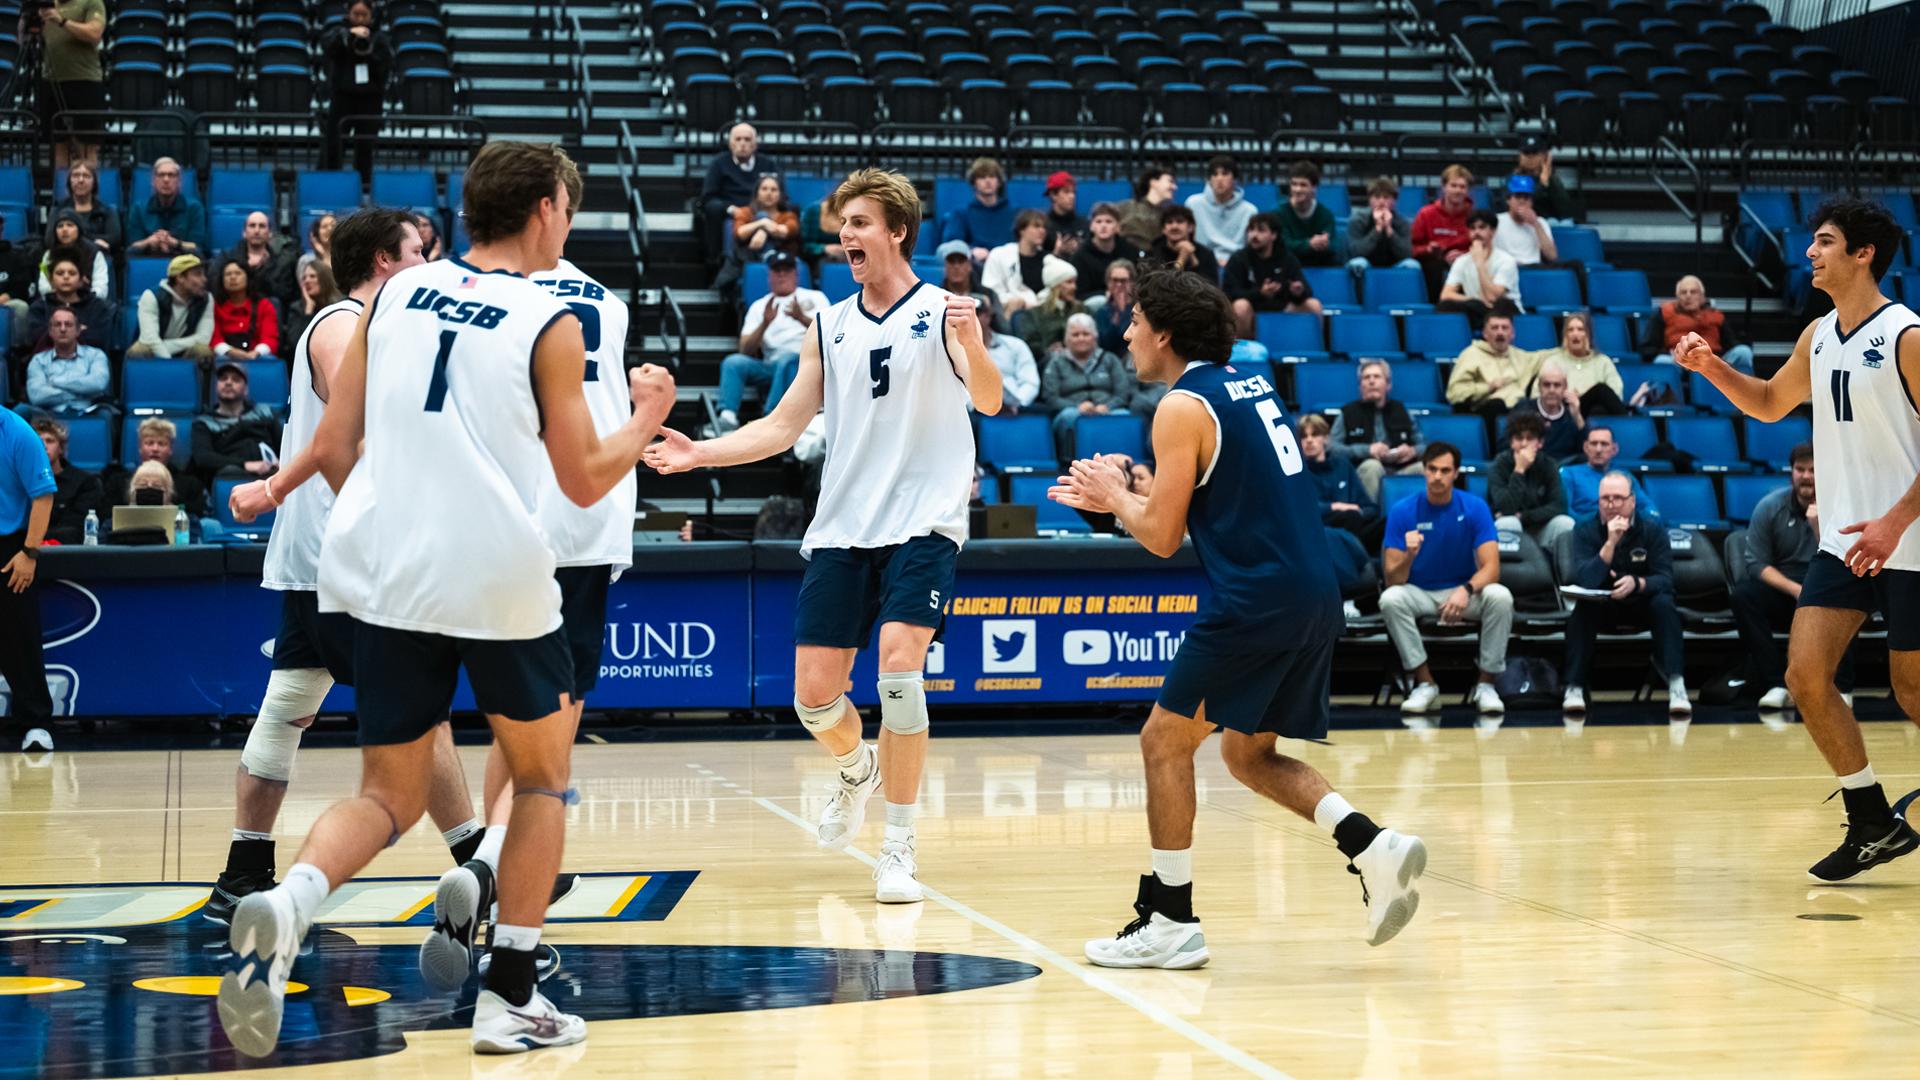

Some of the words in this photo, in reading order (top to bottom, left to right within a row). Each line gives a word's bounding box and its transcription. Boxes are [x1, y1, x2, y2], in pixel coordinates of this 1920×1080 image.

[405, 287, 509, 330] UCSB
[423, 329, 458, 413] 1
[869, 345, 892, 399] 5
[1223, 374, 1274, 402] UCSB
[1831, 369, 1853, 422] 11
[1255, 398, 1303, 476] 6
[929, 589, 940, 609] 5
[952, 597, 1008, 615] GAUCHO
[1009, 596, 1062, 615] FOLLOW
[1063, 596, 1083, 614] US
[1085, 596, 1105, 614] ON
[1107, 595, 1153, 614] SOCIAL
[1157, 595, 1198, 613] MEDIA
[603, 621, 716, 661] UND
[598, 663, 714, 679] PPORTUNITIES
